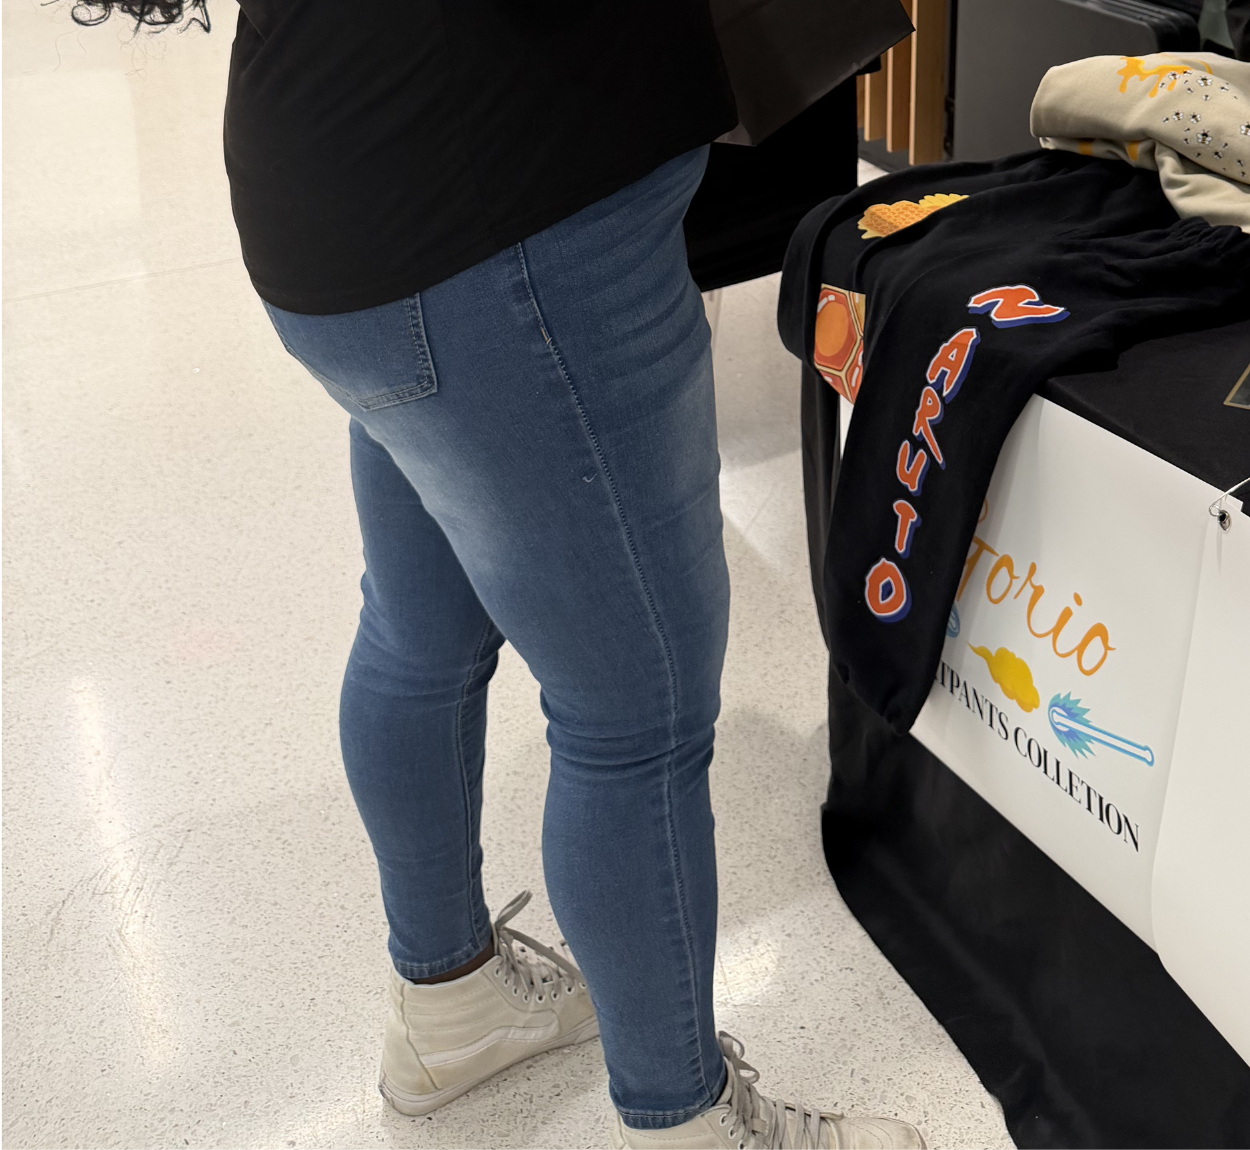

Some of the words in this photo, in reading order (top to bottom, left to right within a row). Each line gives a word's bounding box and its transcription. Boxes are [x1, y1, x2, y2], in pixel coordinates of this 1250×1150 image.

[865, 285, 1069, 622] NARUTO
[936, 660, 1009, 741] TPANTS
[1013, 726, 1140, 853] COLLETION
